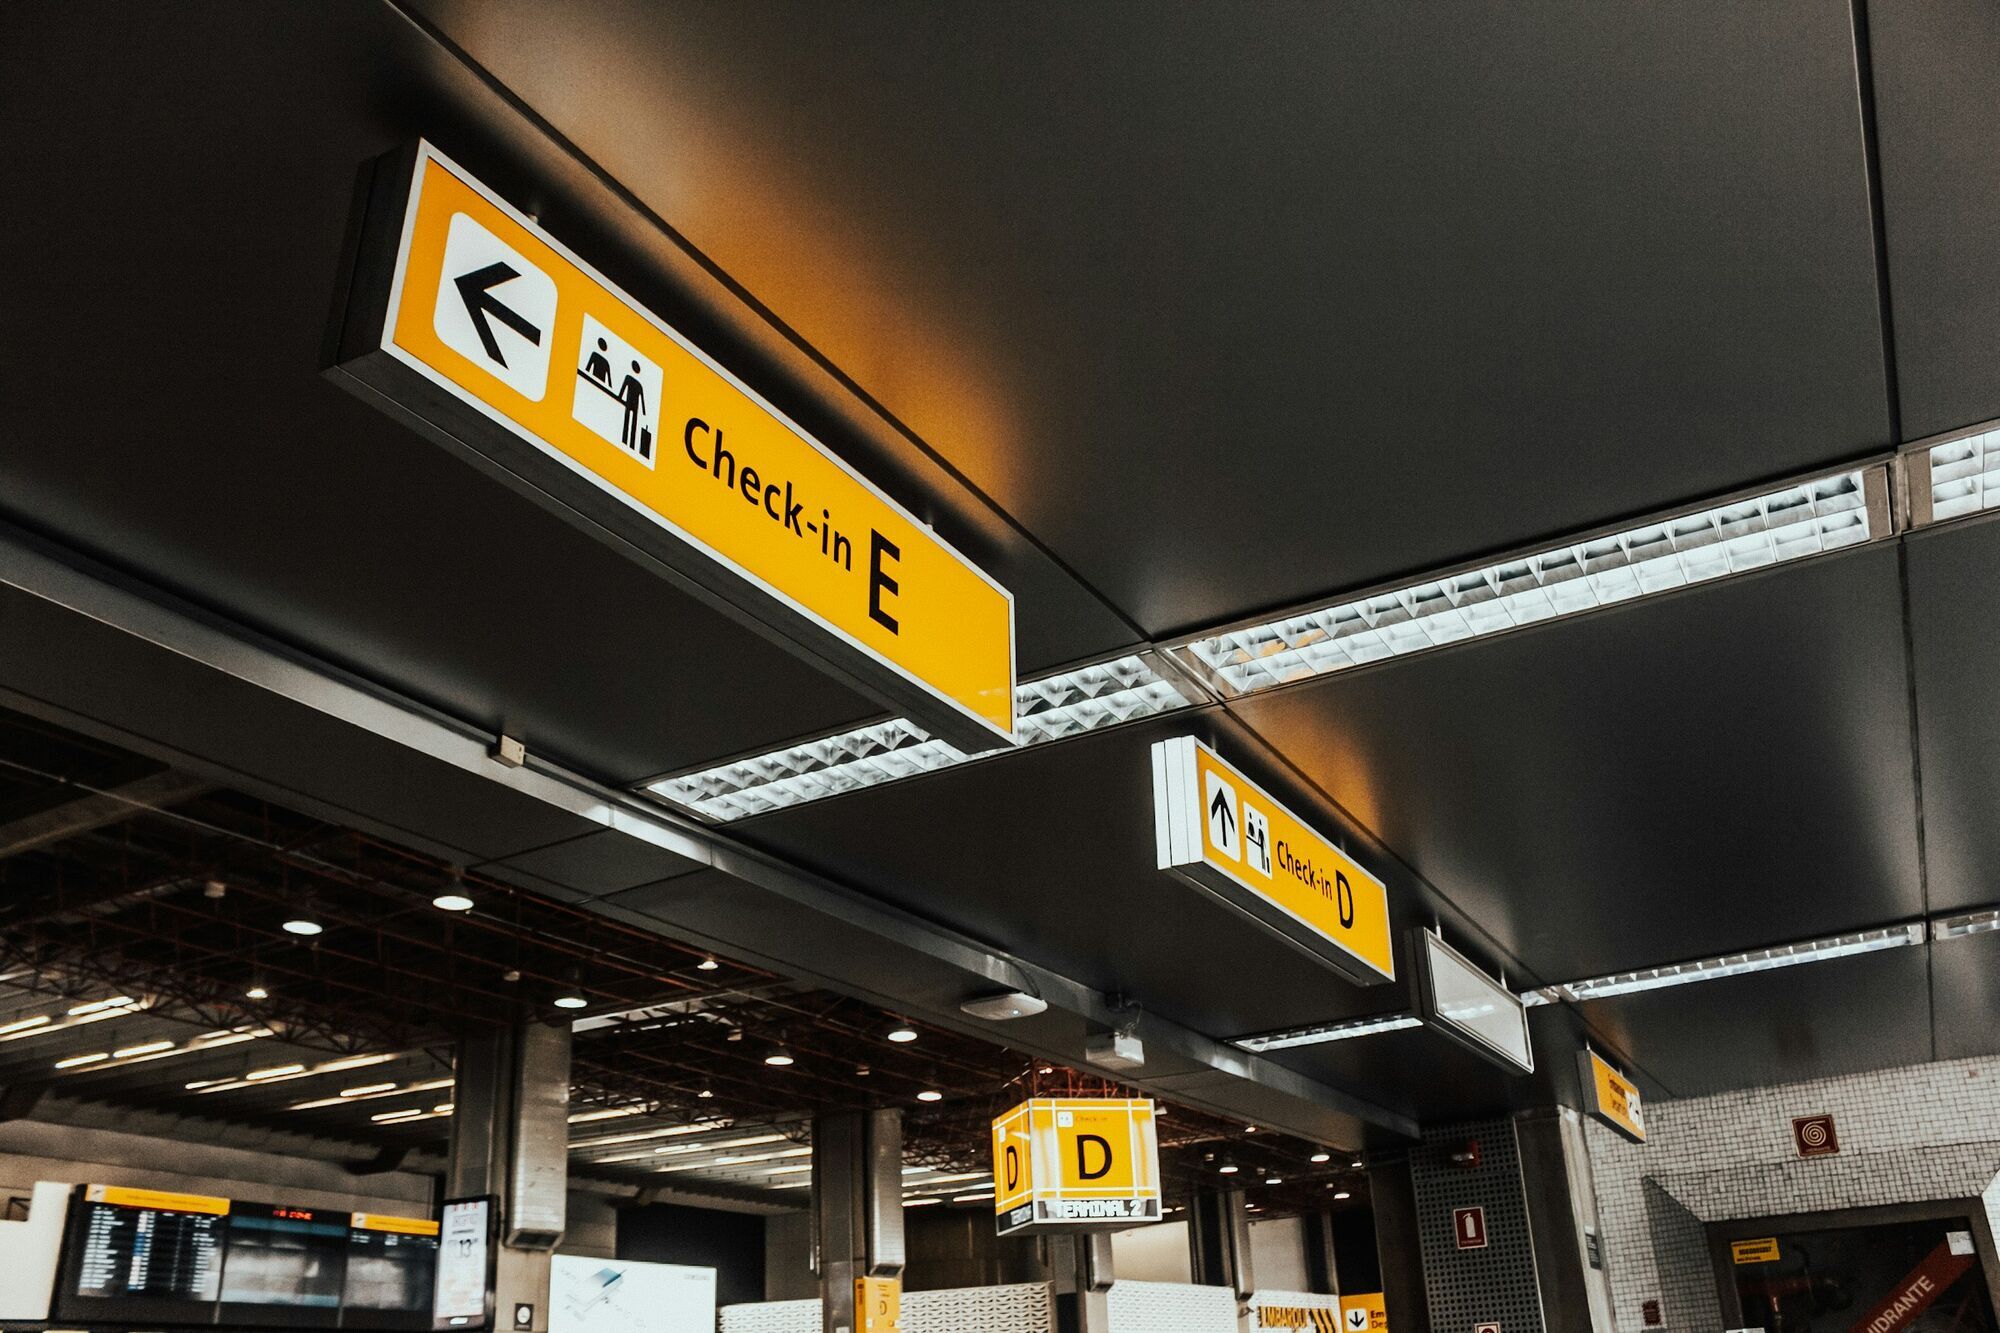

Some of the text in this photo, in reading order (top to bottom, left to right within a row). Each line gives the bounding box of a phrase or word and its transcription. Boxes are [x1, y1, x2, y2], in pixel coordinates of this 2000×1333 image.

[684, 417, 901, 637] Check-in E
[1277, 840, 1354, 930] Check-in D
[1006, 1145, 1018, 1191] D
[1076, 1134, 1113, 1180] D
[1055, 1199, 1142, 1218] TERMINAL 2
